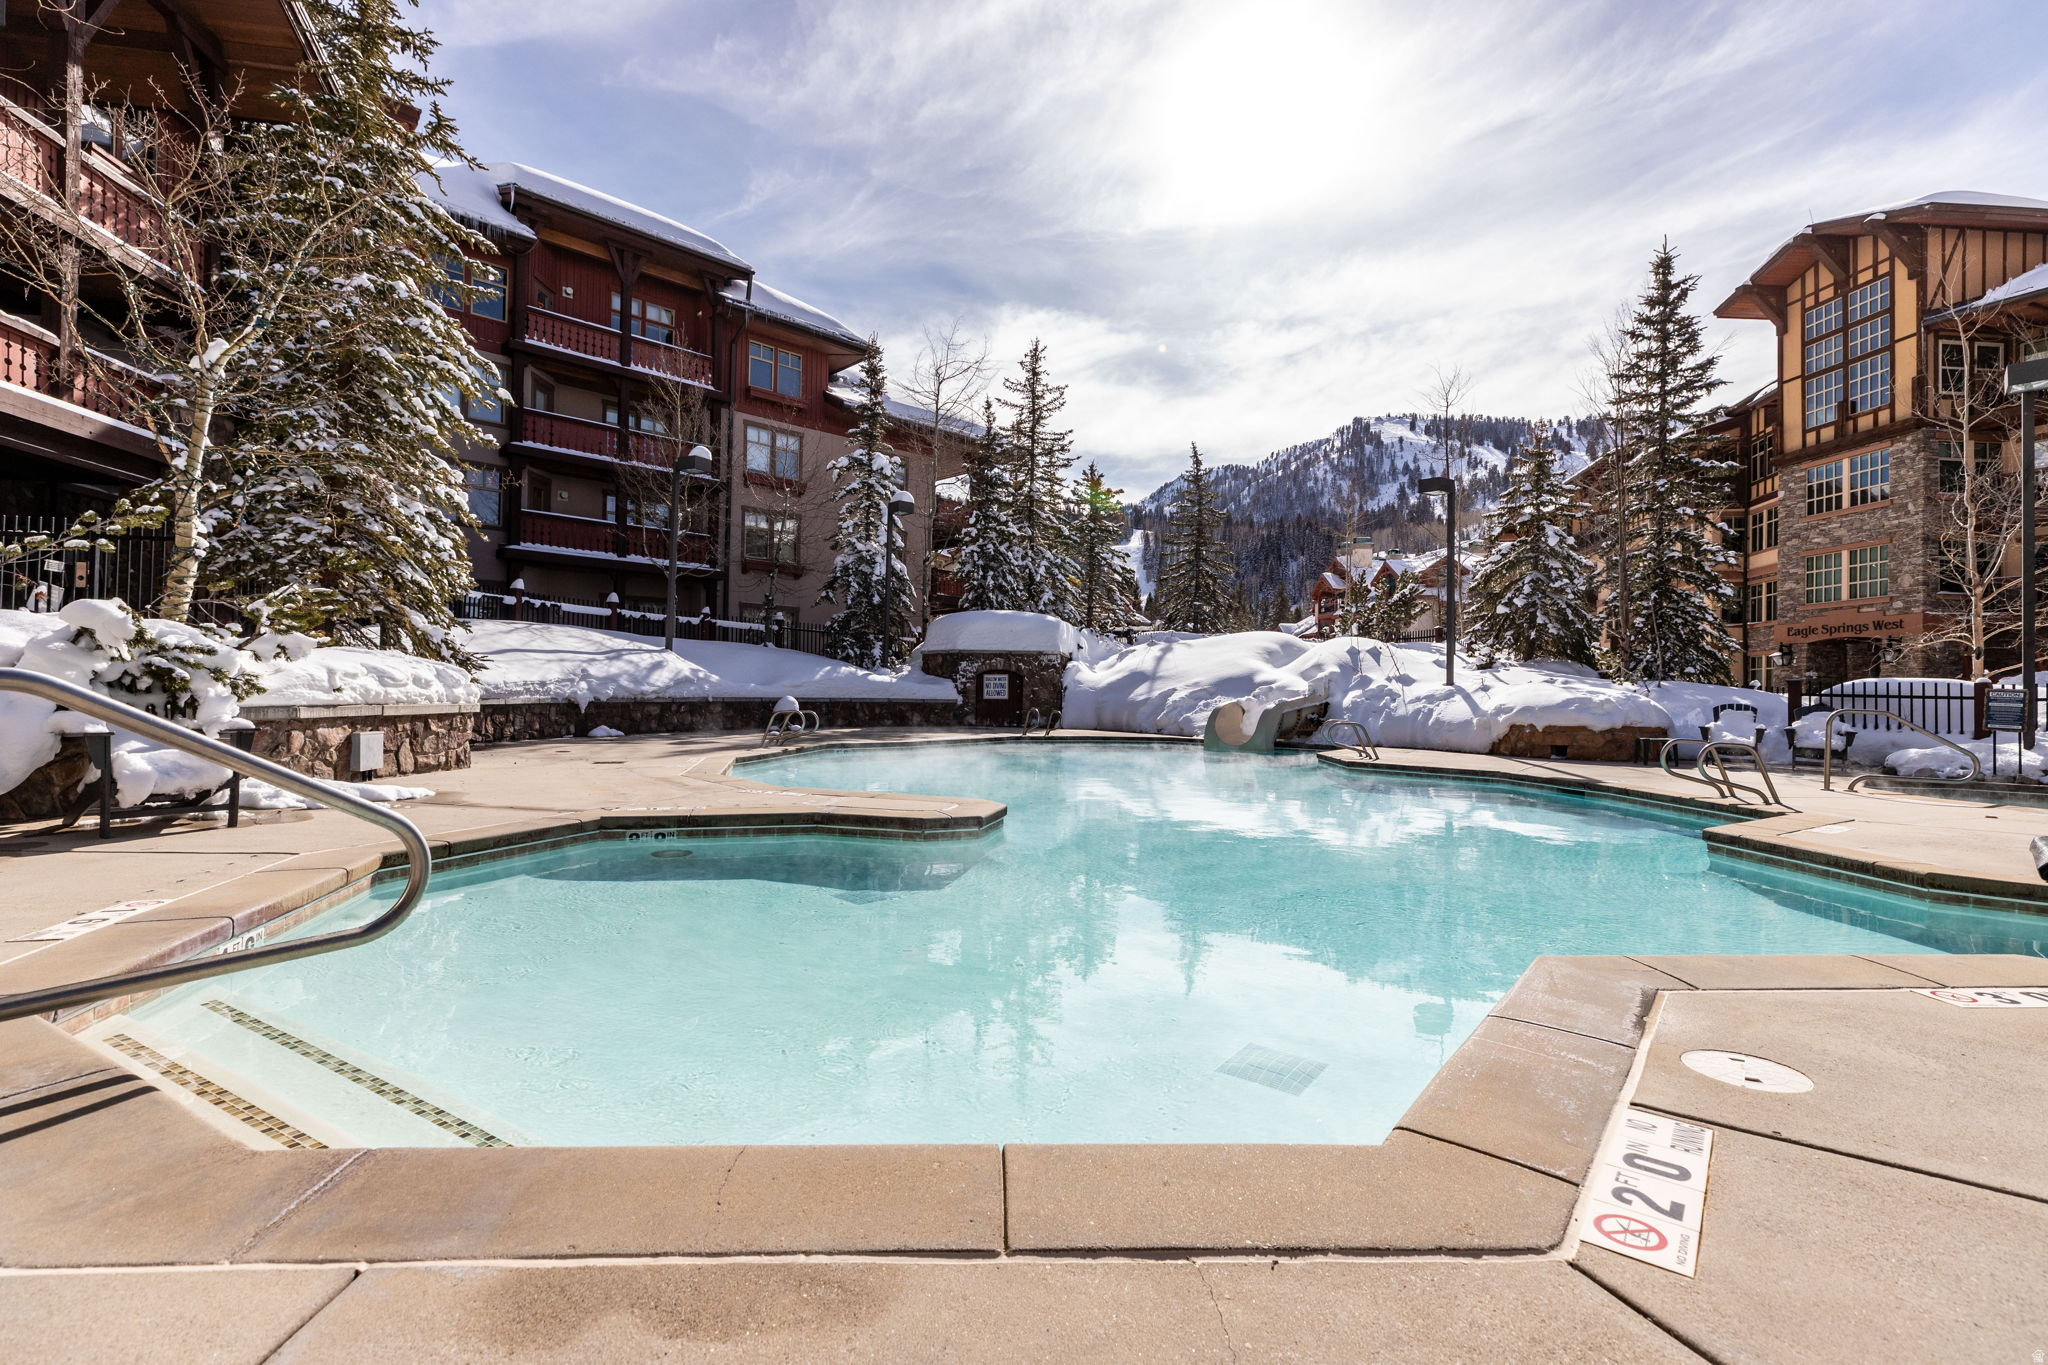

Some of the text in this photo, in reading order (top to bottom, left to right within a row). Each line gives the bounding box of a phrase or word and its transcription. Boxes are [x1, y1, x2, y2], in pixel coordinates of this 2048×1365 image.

[1787, 618, 1905, 639] Eagle Springs West
[1974, 991, 2022, 1004] 3
[1625, 1118, 1658, 1135] NO
[1670, 1122, 1707, 1156] RUNNING
[1611, 1140, 1692, 1222] 2 FT 0 IN
[1676, 1234, 1690, 1266] NO DIVING
